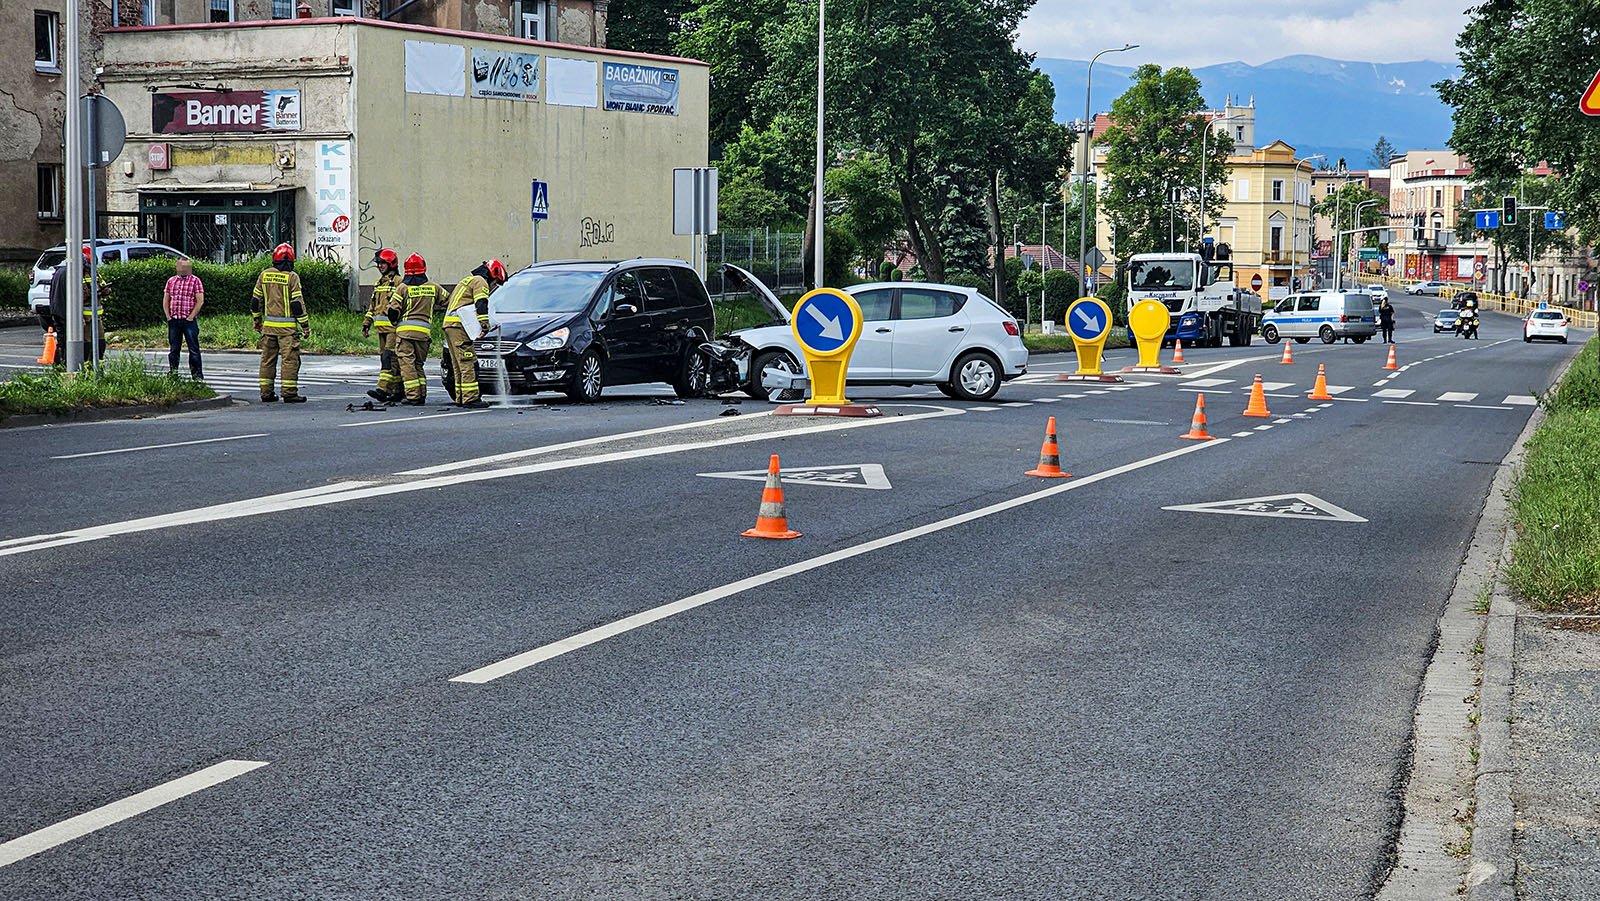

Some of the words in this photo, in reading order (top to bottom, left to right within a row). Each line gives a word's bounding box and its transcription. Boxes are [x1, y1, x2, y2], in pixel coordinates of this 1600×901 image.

[606, 66, 661, 85] BAGAŻNIKI
[663, 73, 676, 82] CRUZ
[186, 100, 261, 126] Banner
[606, 101, 625, 110] MONT
[625, 103, 645, 112] BLANC
[150, 153, 164, 162] STOP
[319, 144, 346, 215] KLIMA
